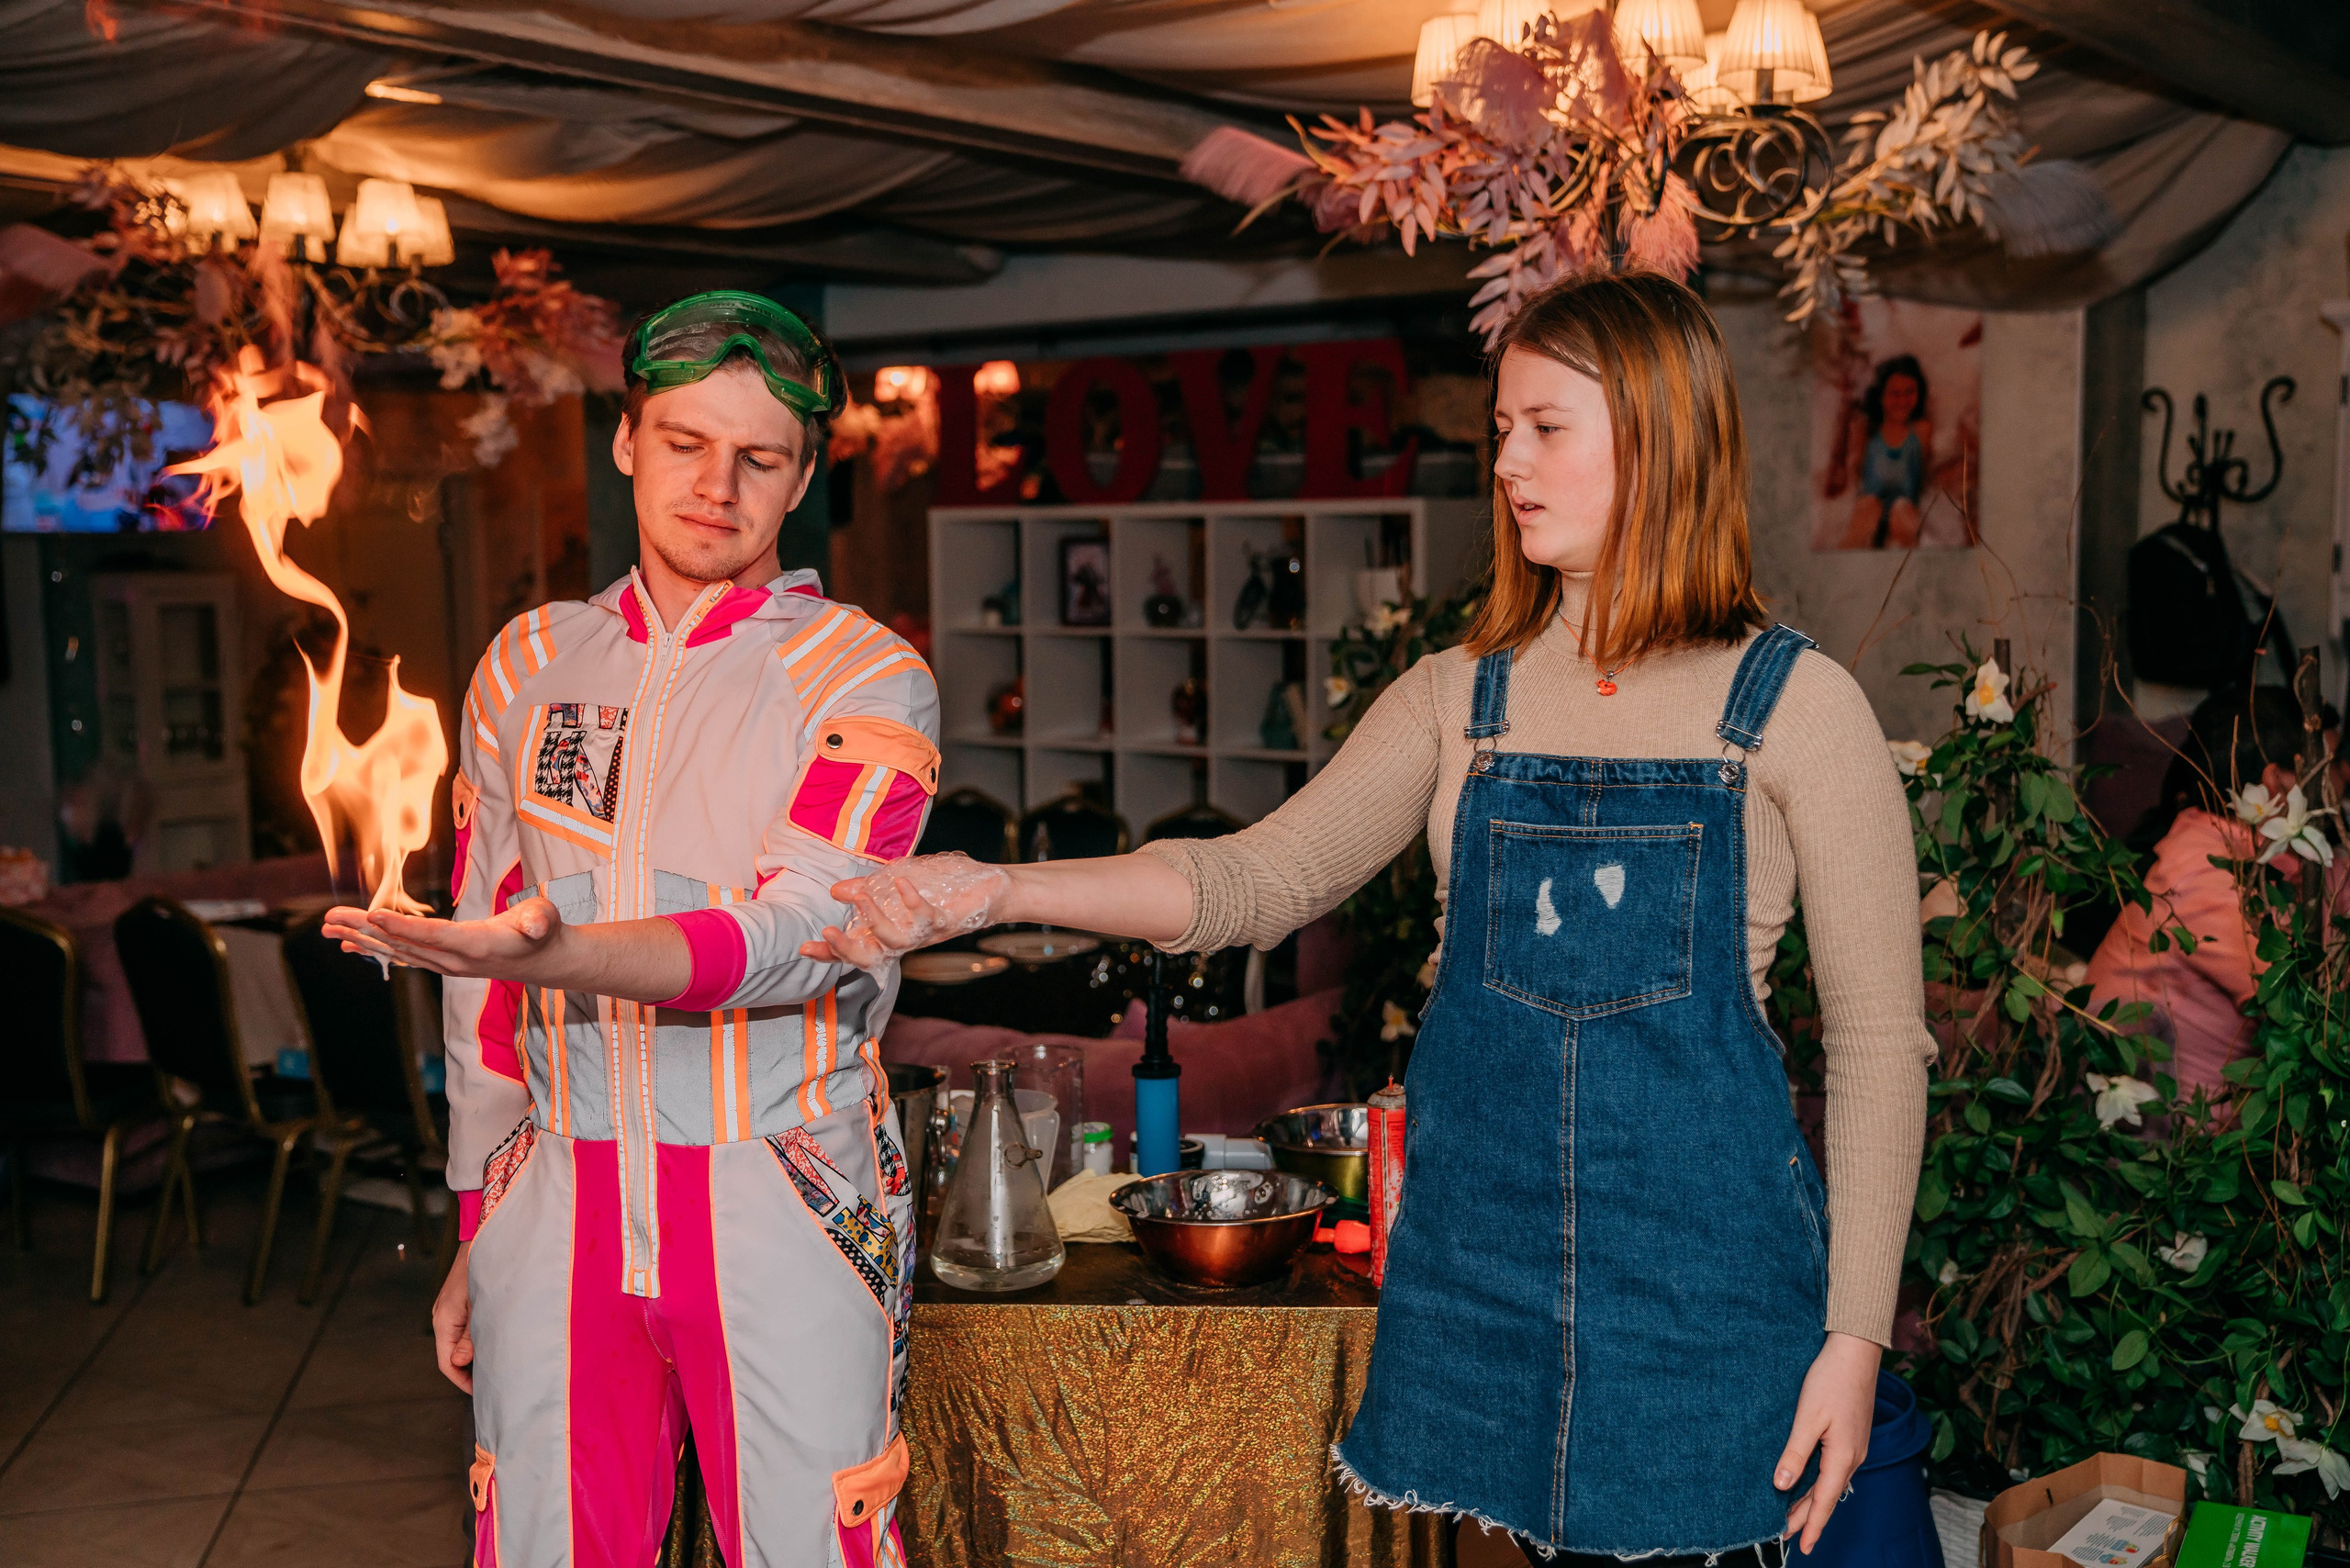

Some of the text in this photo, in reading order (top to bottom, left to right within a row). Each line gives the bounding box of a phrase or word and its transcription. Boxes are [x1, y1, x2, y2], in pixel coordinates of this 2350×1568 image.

[932, 338, 1418, 506] LOVE
[2238, 1514, 2267, 1568] ACTIVITY WALKER
